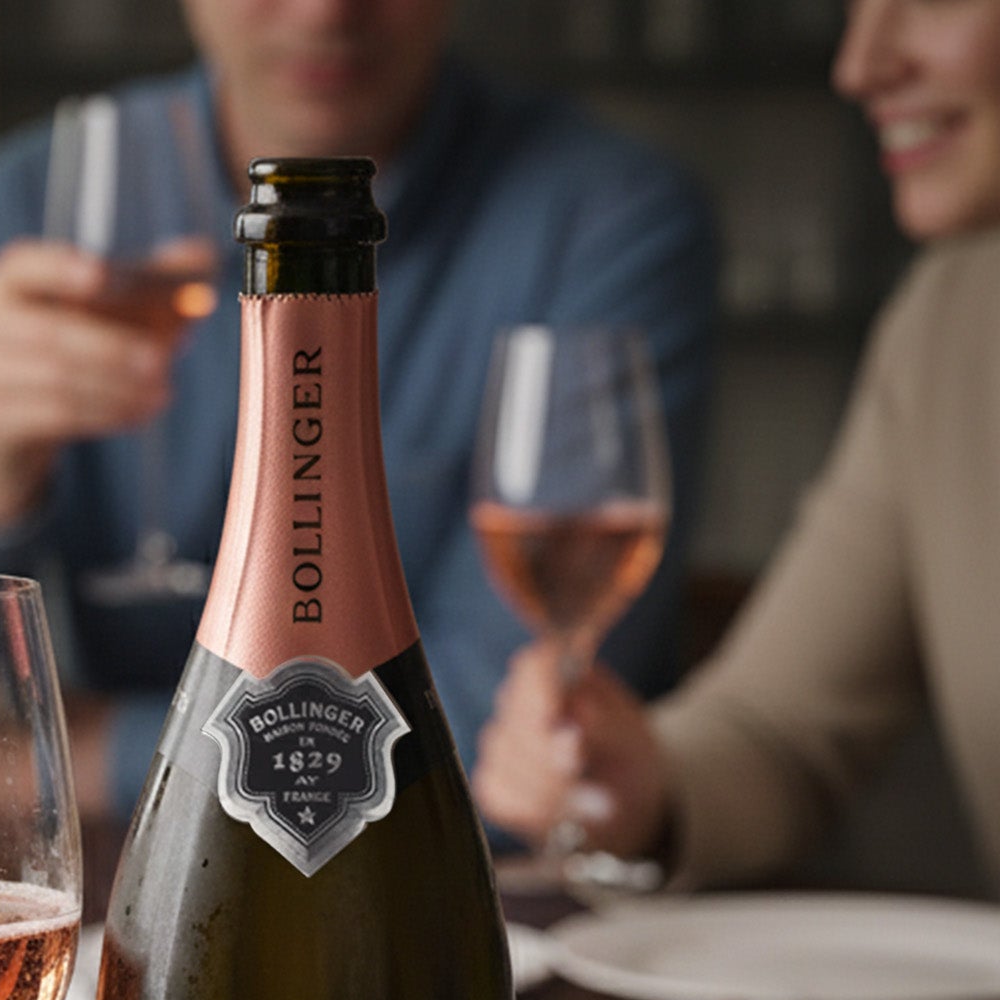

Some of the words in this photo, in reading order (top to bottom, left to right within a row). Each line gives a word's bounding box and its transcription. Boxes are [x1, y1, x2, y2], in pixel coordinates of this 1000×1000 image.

[292, 346, 322, 624] BOLLINGER
[249, 702, 365, 735] BOLLINGER
[273, 751, 342, 773] 1829
